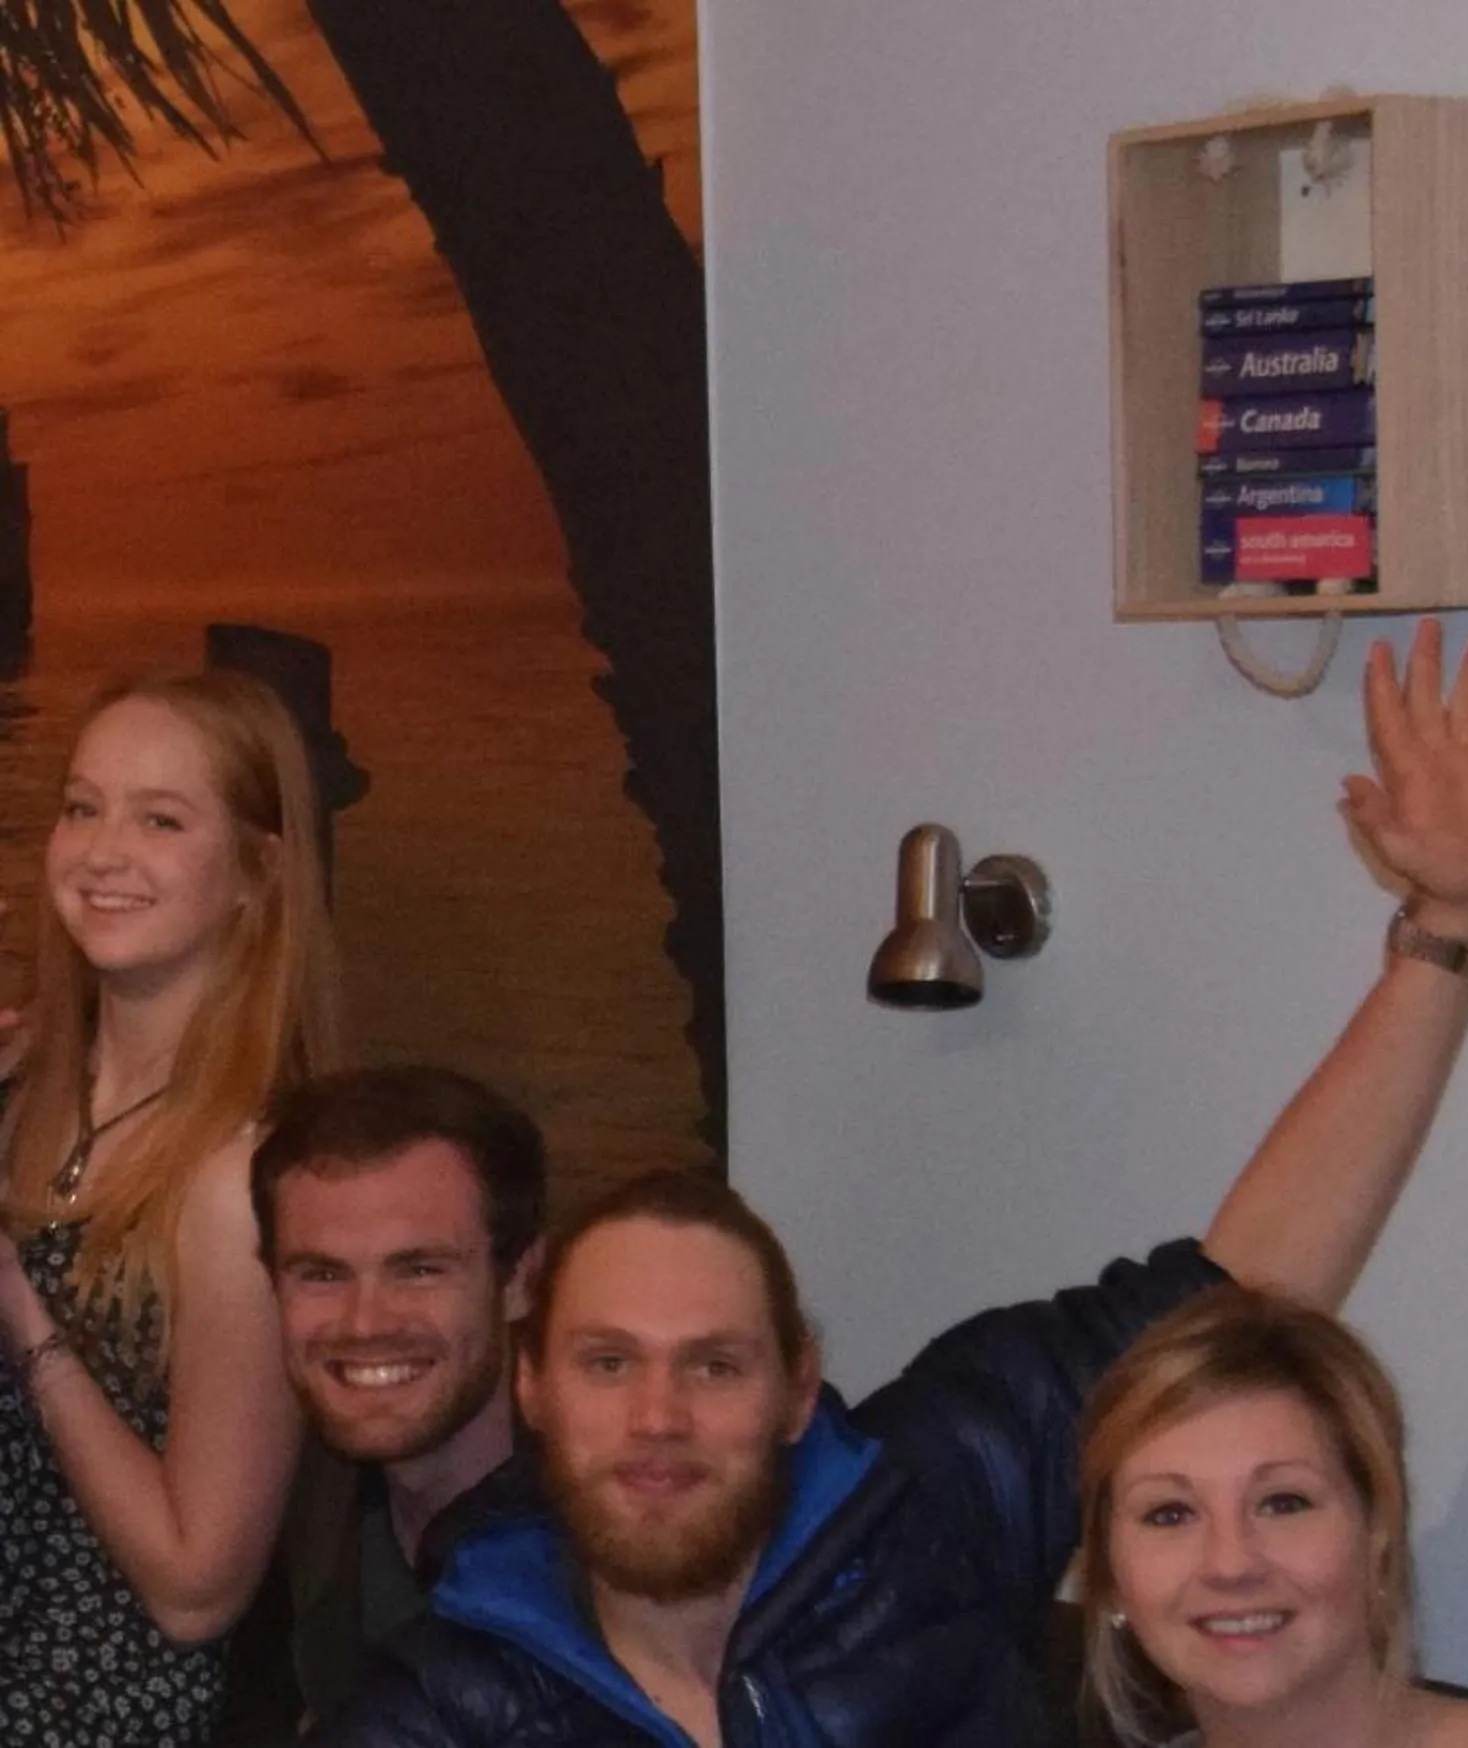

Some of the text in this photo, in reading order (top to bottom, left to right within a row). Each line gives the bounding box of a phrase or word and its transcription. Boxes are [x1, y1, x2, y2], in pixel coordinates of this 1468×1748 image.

[1239, 350, 1339, 379] Australia
[1240, 407, 1321, 433] Canada
[1237, 485, 1324, 510] Argentina
[1240, 533, 1287, 550] south
